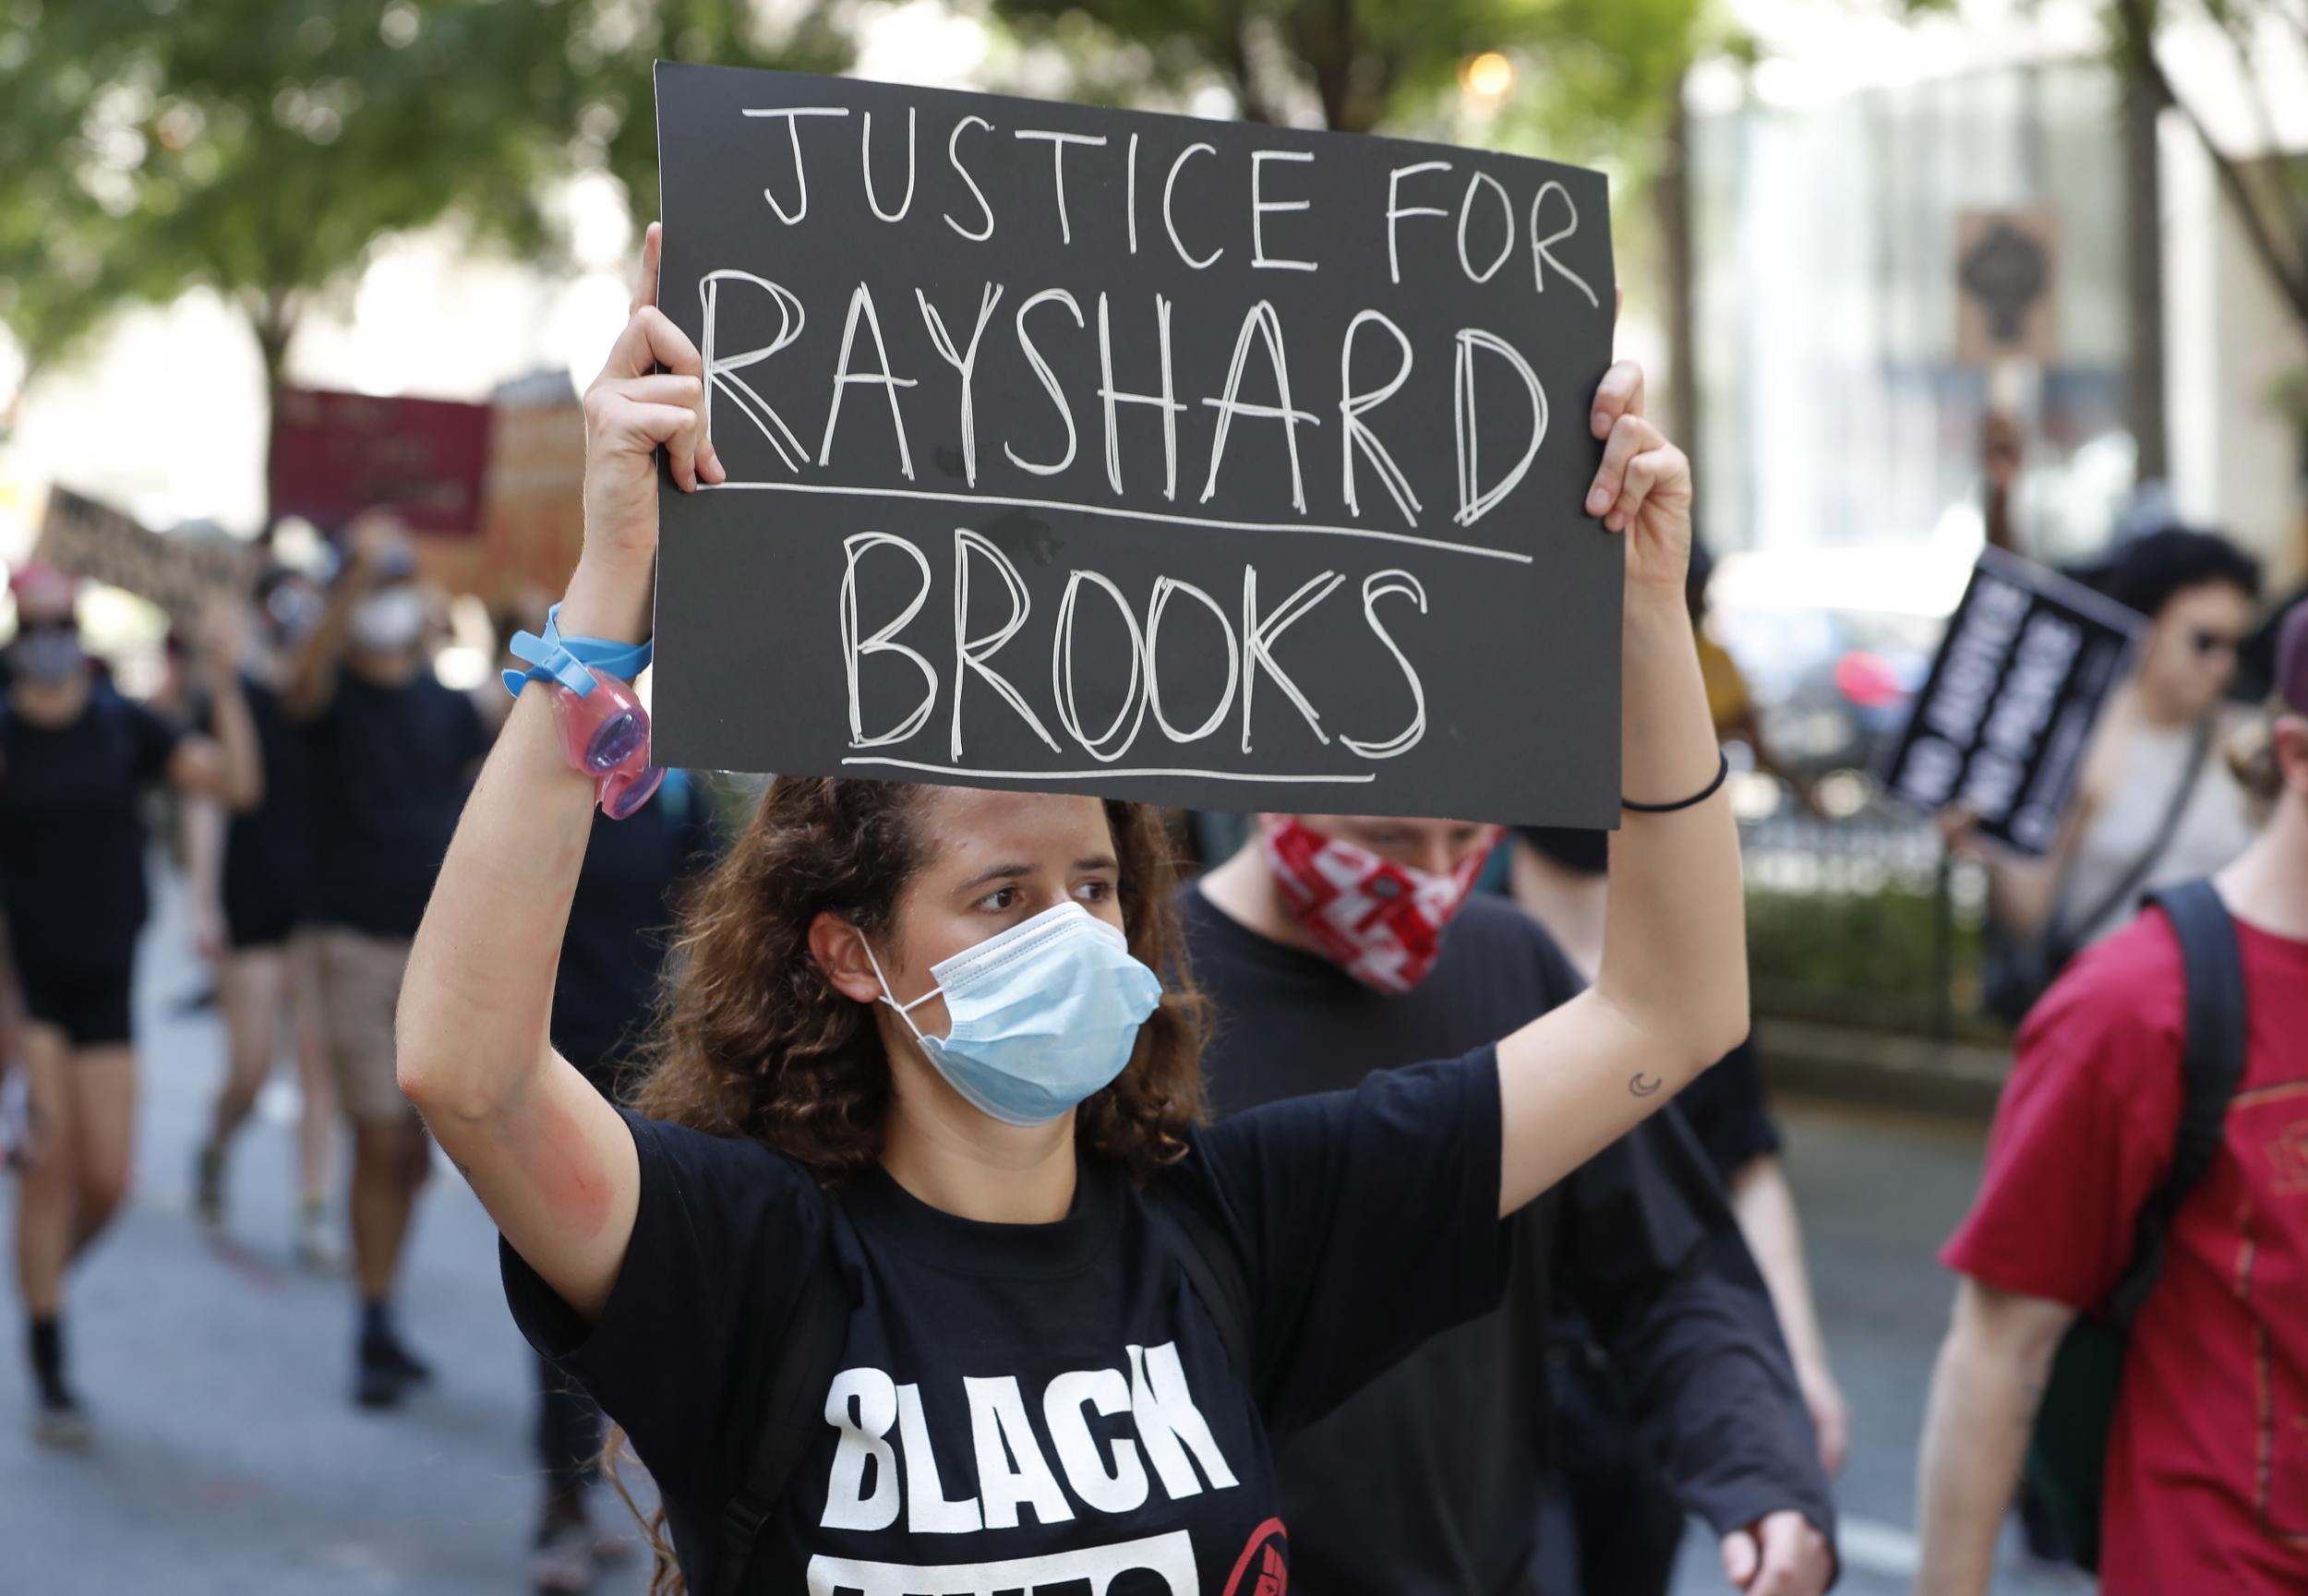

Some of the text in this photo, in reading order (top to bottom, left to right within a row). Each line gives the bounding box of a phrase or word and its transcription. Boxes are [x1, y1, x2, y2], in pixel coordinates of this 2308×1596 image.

[741, 106, 1598, 307] JUSTICE FOR
[699, 269, 1549, 528] RAYSHARD
[840, 527, 1427, 762] BROOKS
[819, 1340, 1240, 1533] BLACK
